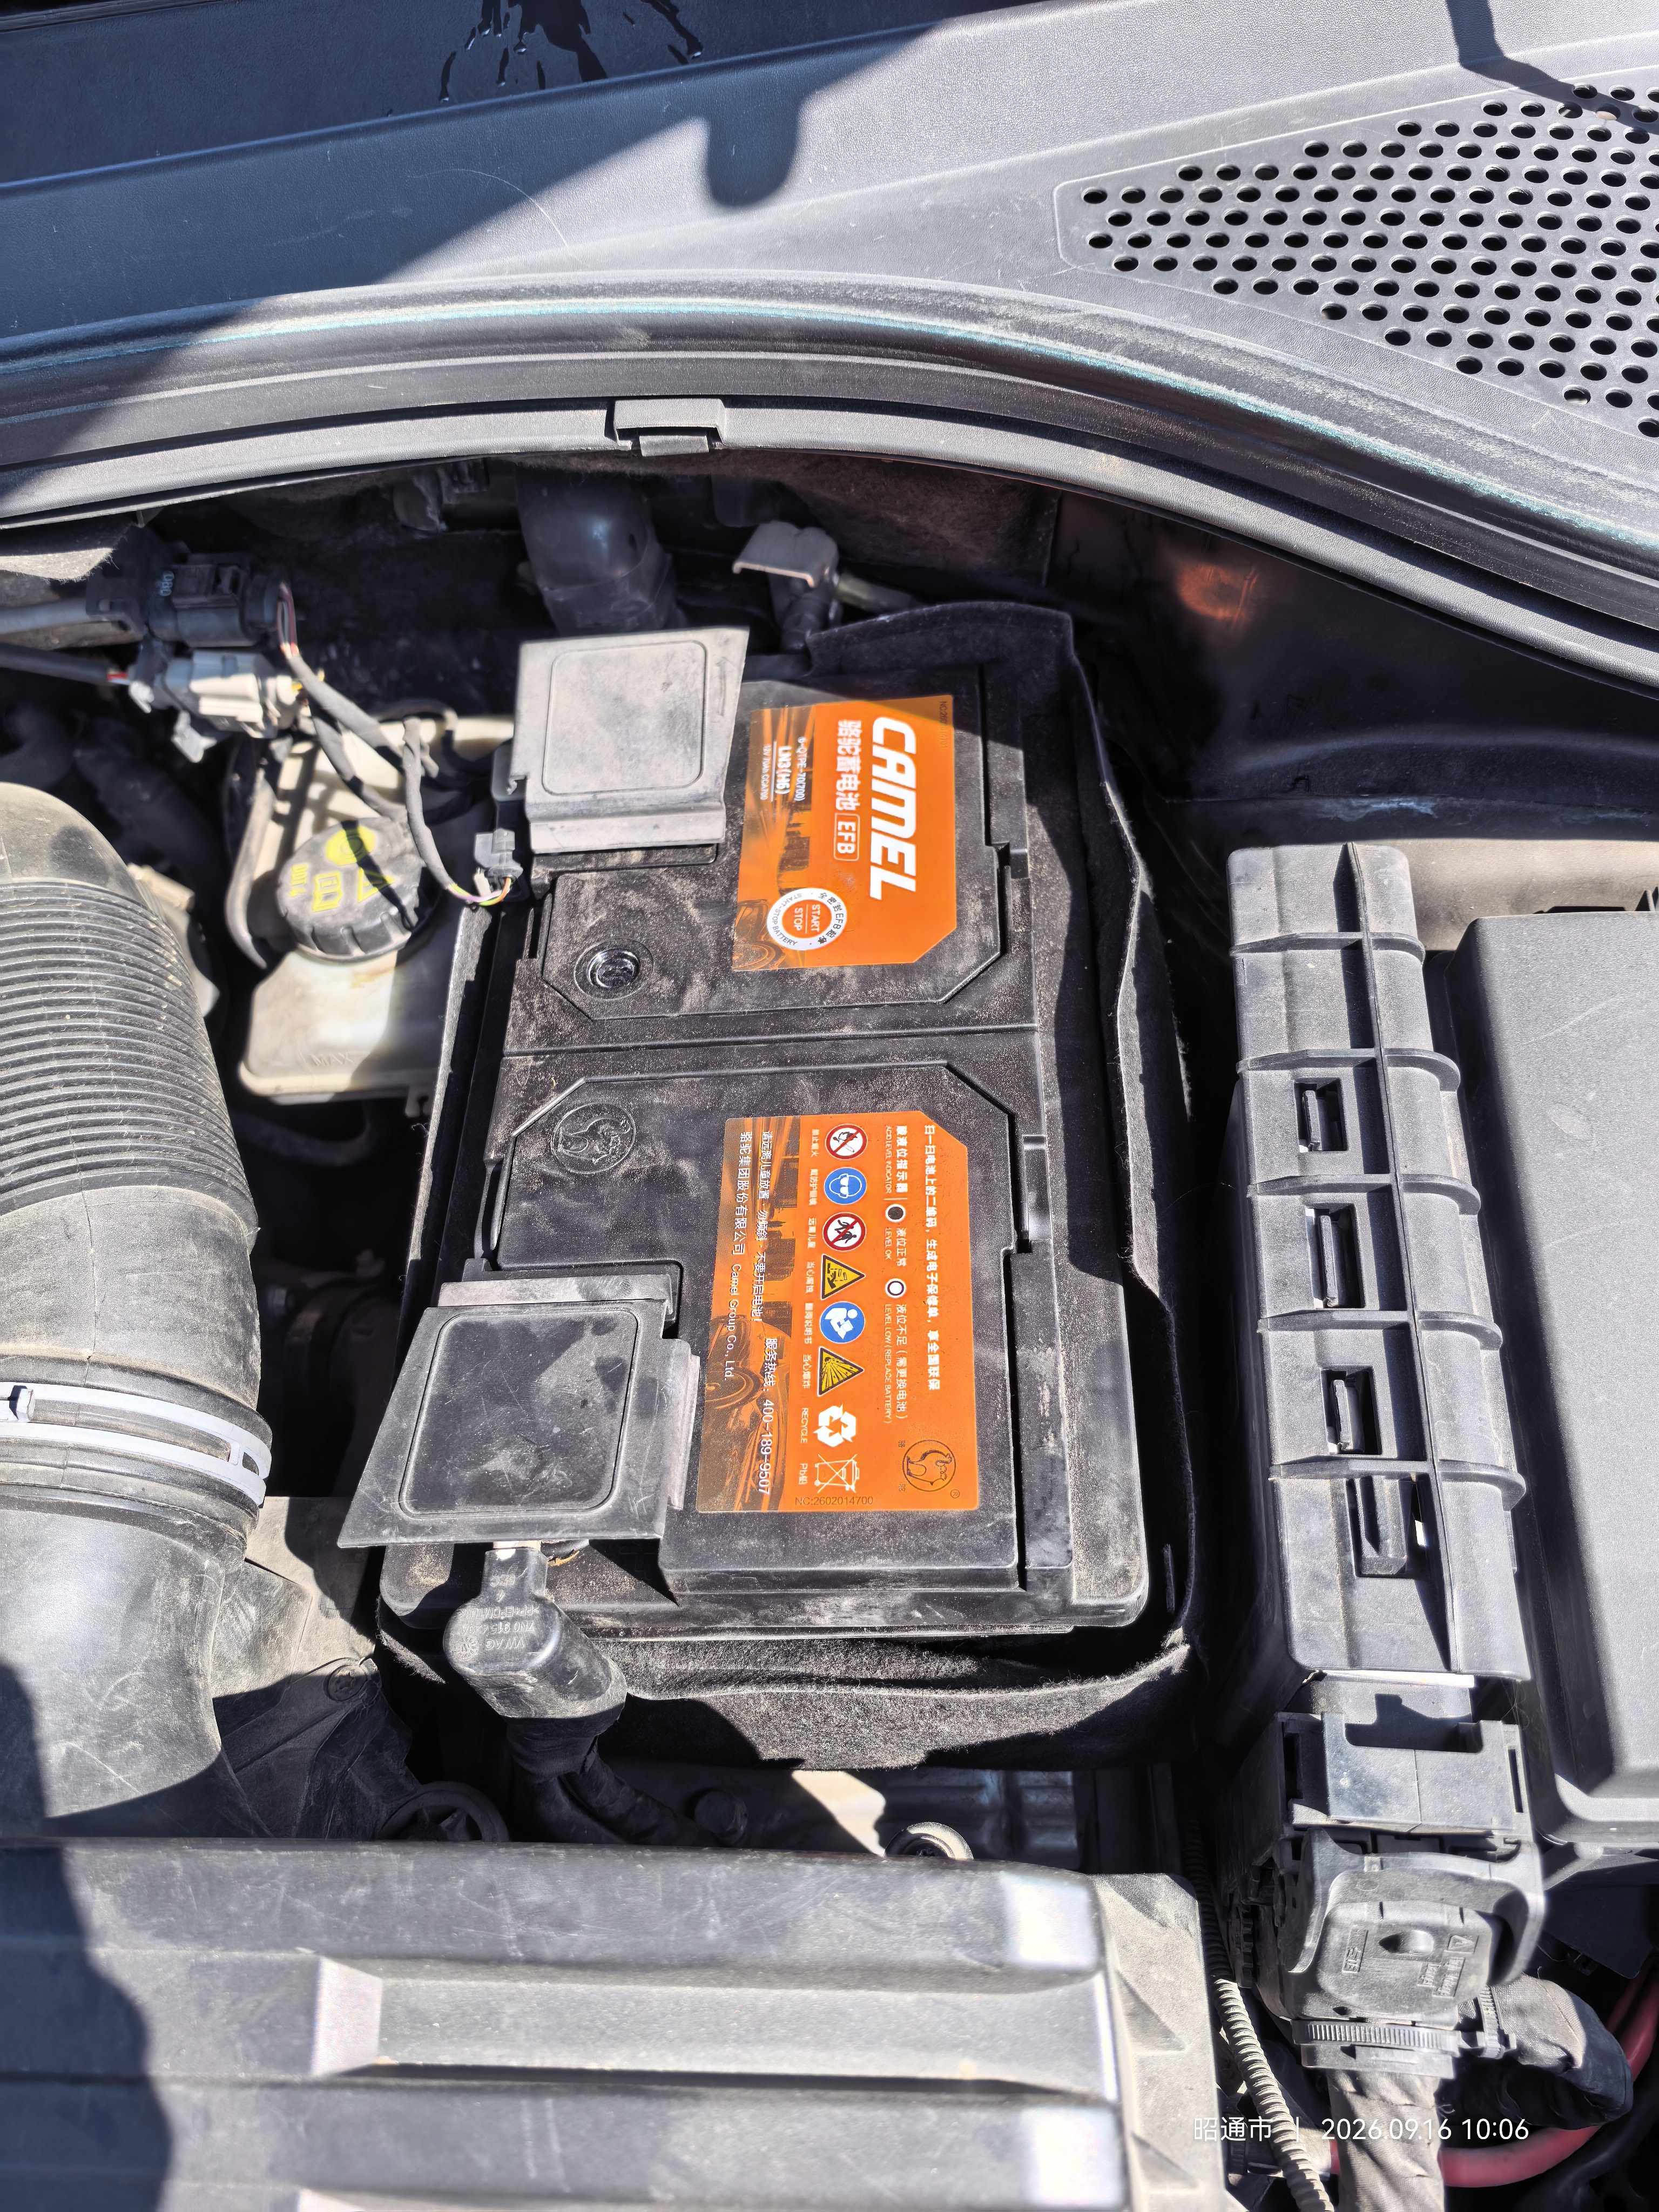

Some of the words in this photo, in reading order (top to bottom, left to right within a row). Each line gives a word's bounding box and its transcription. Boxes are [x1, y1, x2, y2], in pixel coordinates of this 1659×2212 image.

[761, 757, 771, 773] 70Ah
[775, 746, 792, 794] LN3(H6)
[835, 720, 862, 811] 骆驼蓄电池
[760, 774, 770, 801] CCA700
[869, 717, 917, 901] CAMEL
[837, 821, 855, 854] EFB
[793, 907, 804, 931] STOP
[810, 904, 820, 933] START
[772, 925, 797, 946] BATTERY
[895, 1125, 908, 1193] 酸液位指示器
[732, 1131, 753, 1256] 骆驼集团股份有限公司
[885, 1249, 892, 1260] OK
[895, 1228, 907, 1267] 液位正常
[730, 1263, 741, 1296] Camel
[726, 1299, 739, 1332] Group
[725, 1334, 737, 1357] Co.,
[724, 1360, 736, 1381] Ltd.
[800, 1407, 809, 1444] RECYCLE
[758, 1399, 774, 1495] 400-189-9507
[795, 1496, 873, 1505] NC:2602014700
[485, 1638, 503, 1650] AG
[503, 1637, 524, 1649] VW
